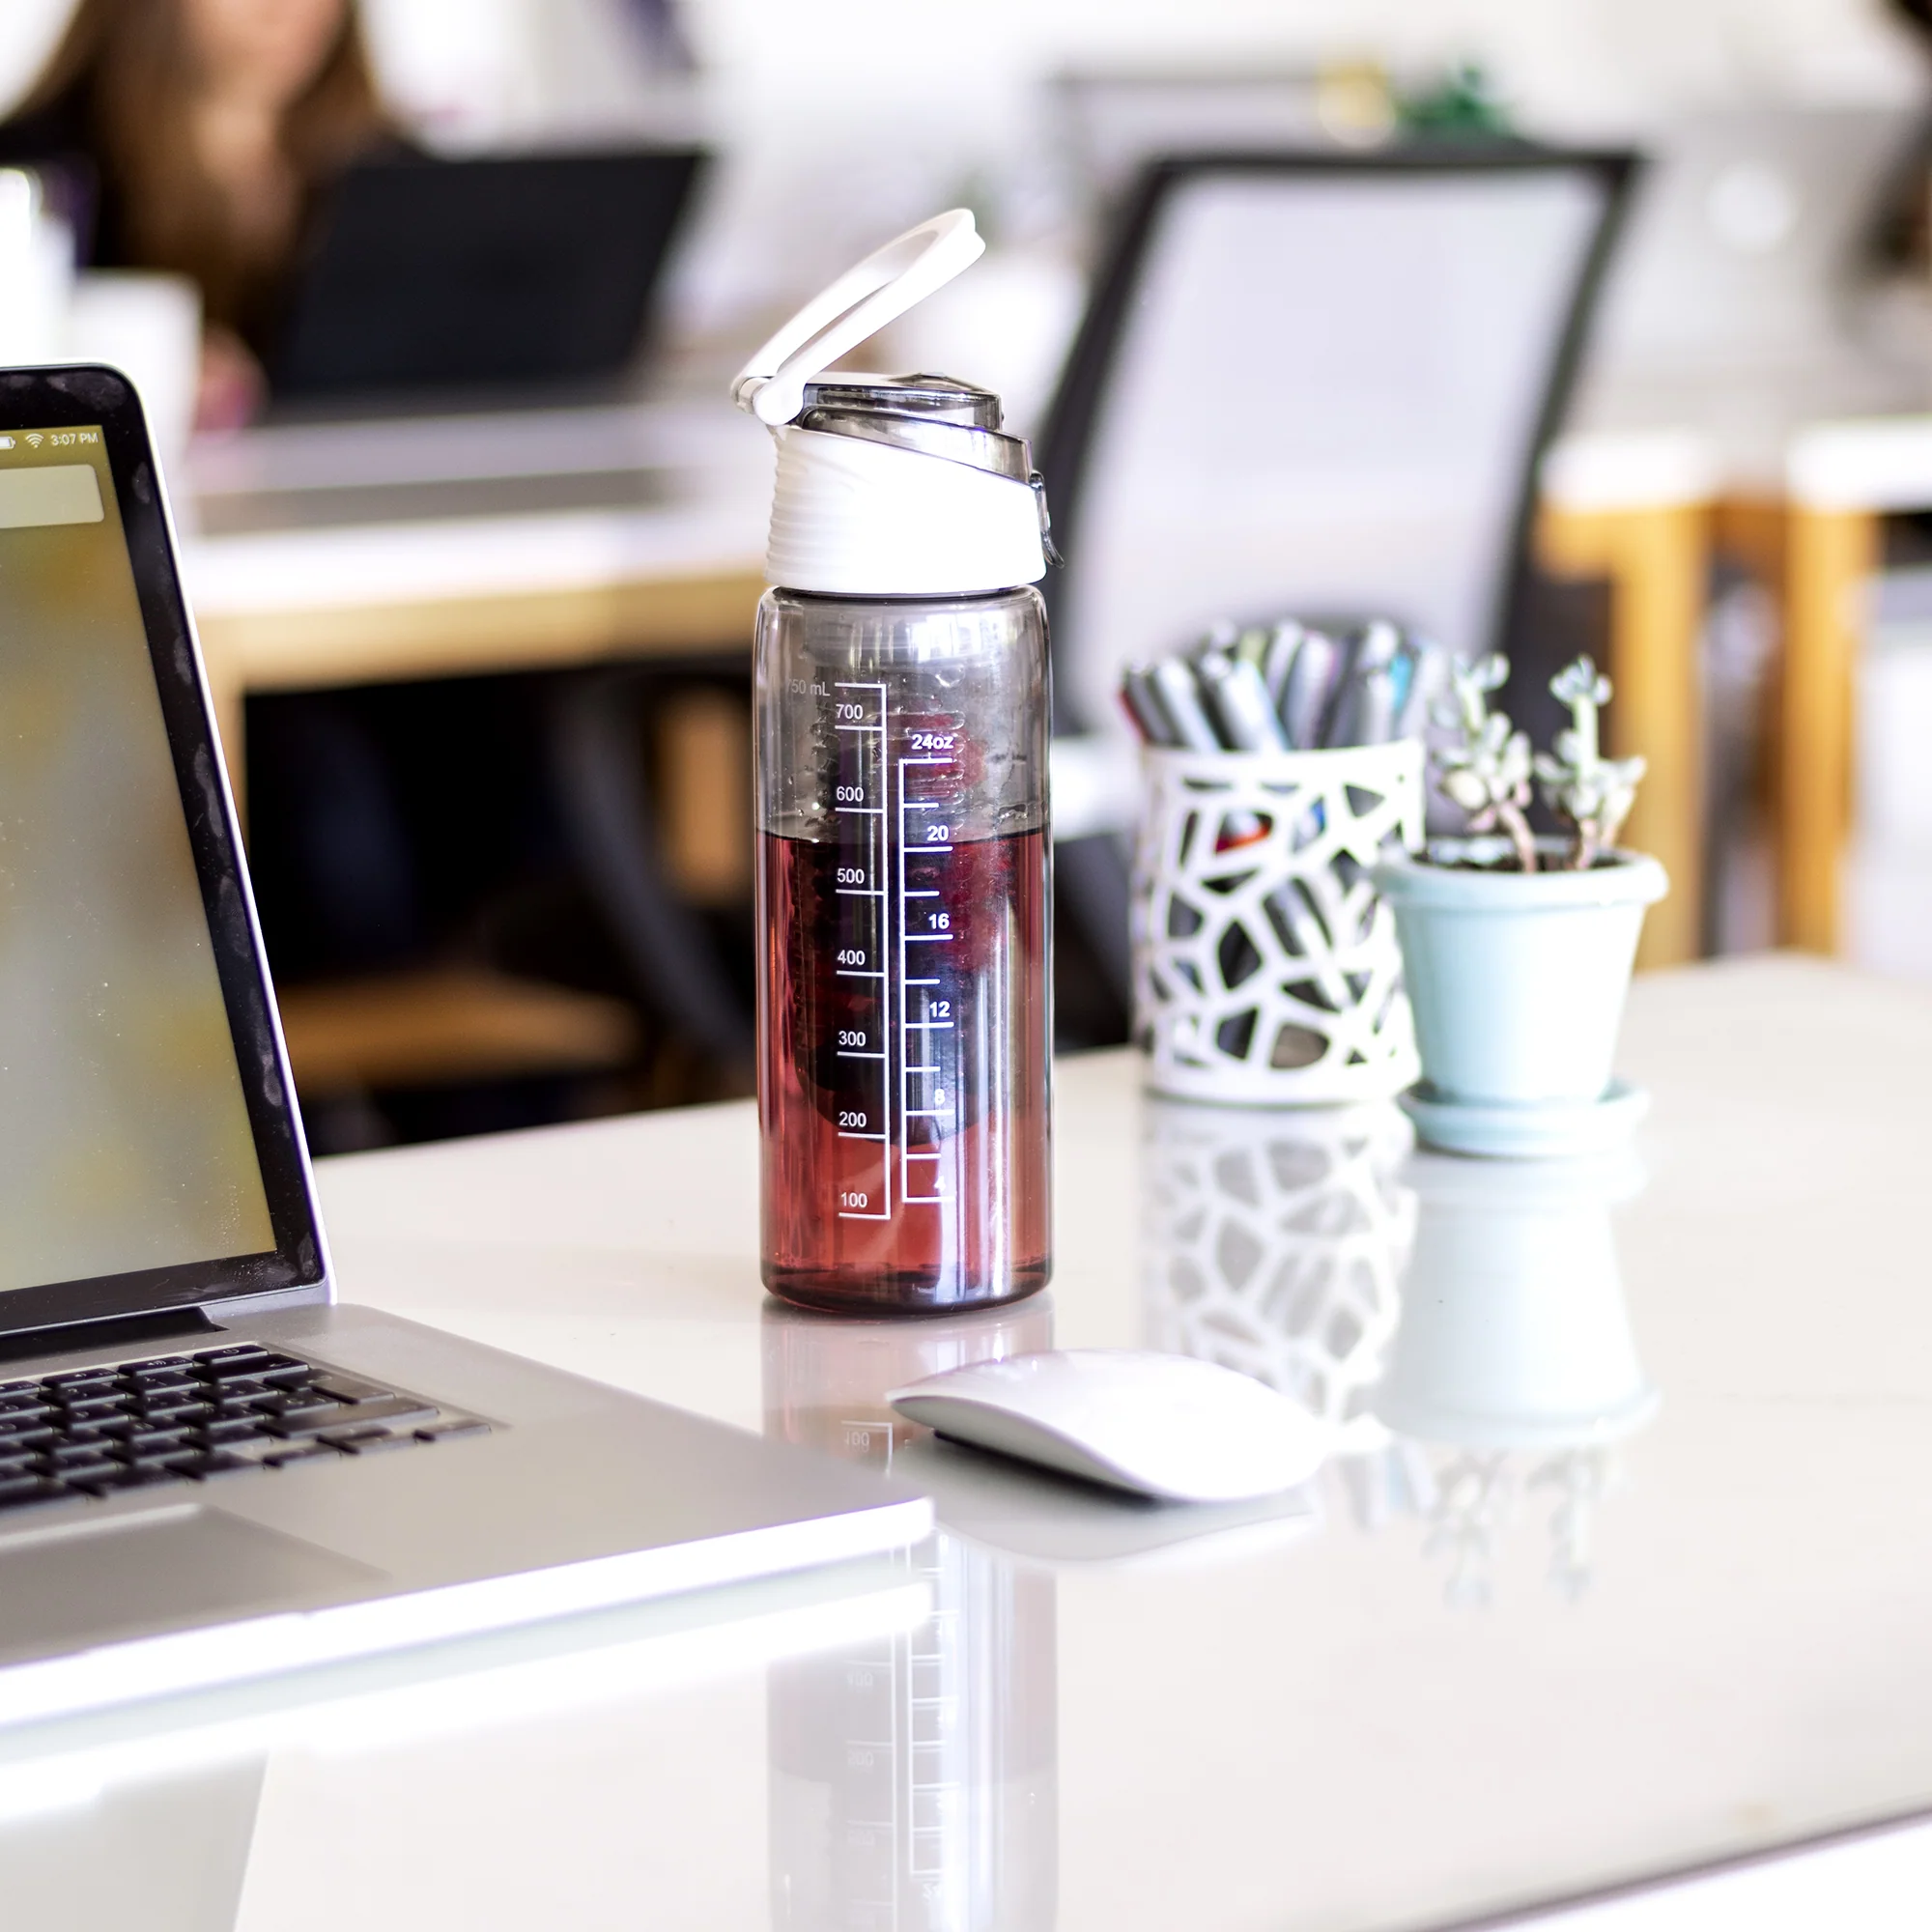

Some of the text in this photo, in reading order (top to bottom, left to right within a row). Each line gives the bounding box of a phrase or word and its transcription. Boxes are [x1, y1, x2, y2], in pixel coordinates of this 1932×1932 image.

[50, 433, 99, 446] 3:07 PM
[810, 681, 831, 696] mL
[836, 703, 864, 720] 700
[911, 734, 954, 751] 24oz
[836, 786, 864, 803] 600
[926, 825, 949, 841] 20
[837, 868, 865, 885] 500
[928, 913, 950, 930] 16
[837, 950, 866, 966] 400
[929, 1001, 951, 1018] 12
[838, 1031, 867, 1047] 300
[934, 1089, 946, 1105] 8
[838, 1111, 867, 1128] 200
[934, 1175, 946, 1192] 4
[840, 1192, 867, 1209] 100
